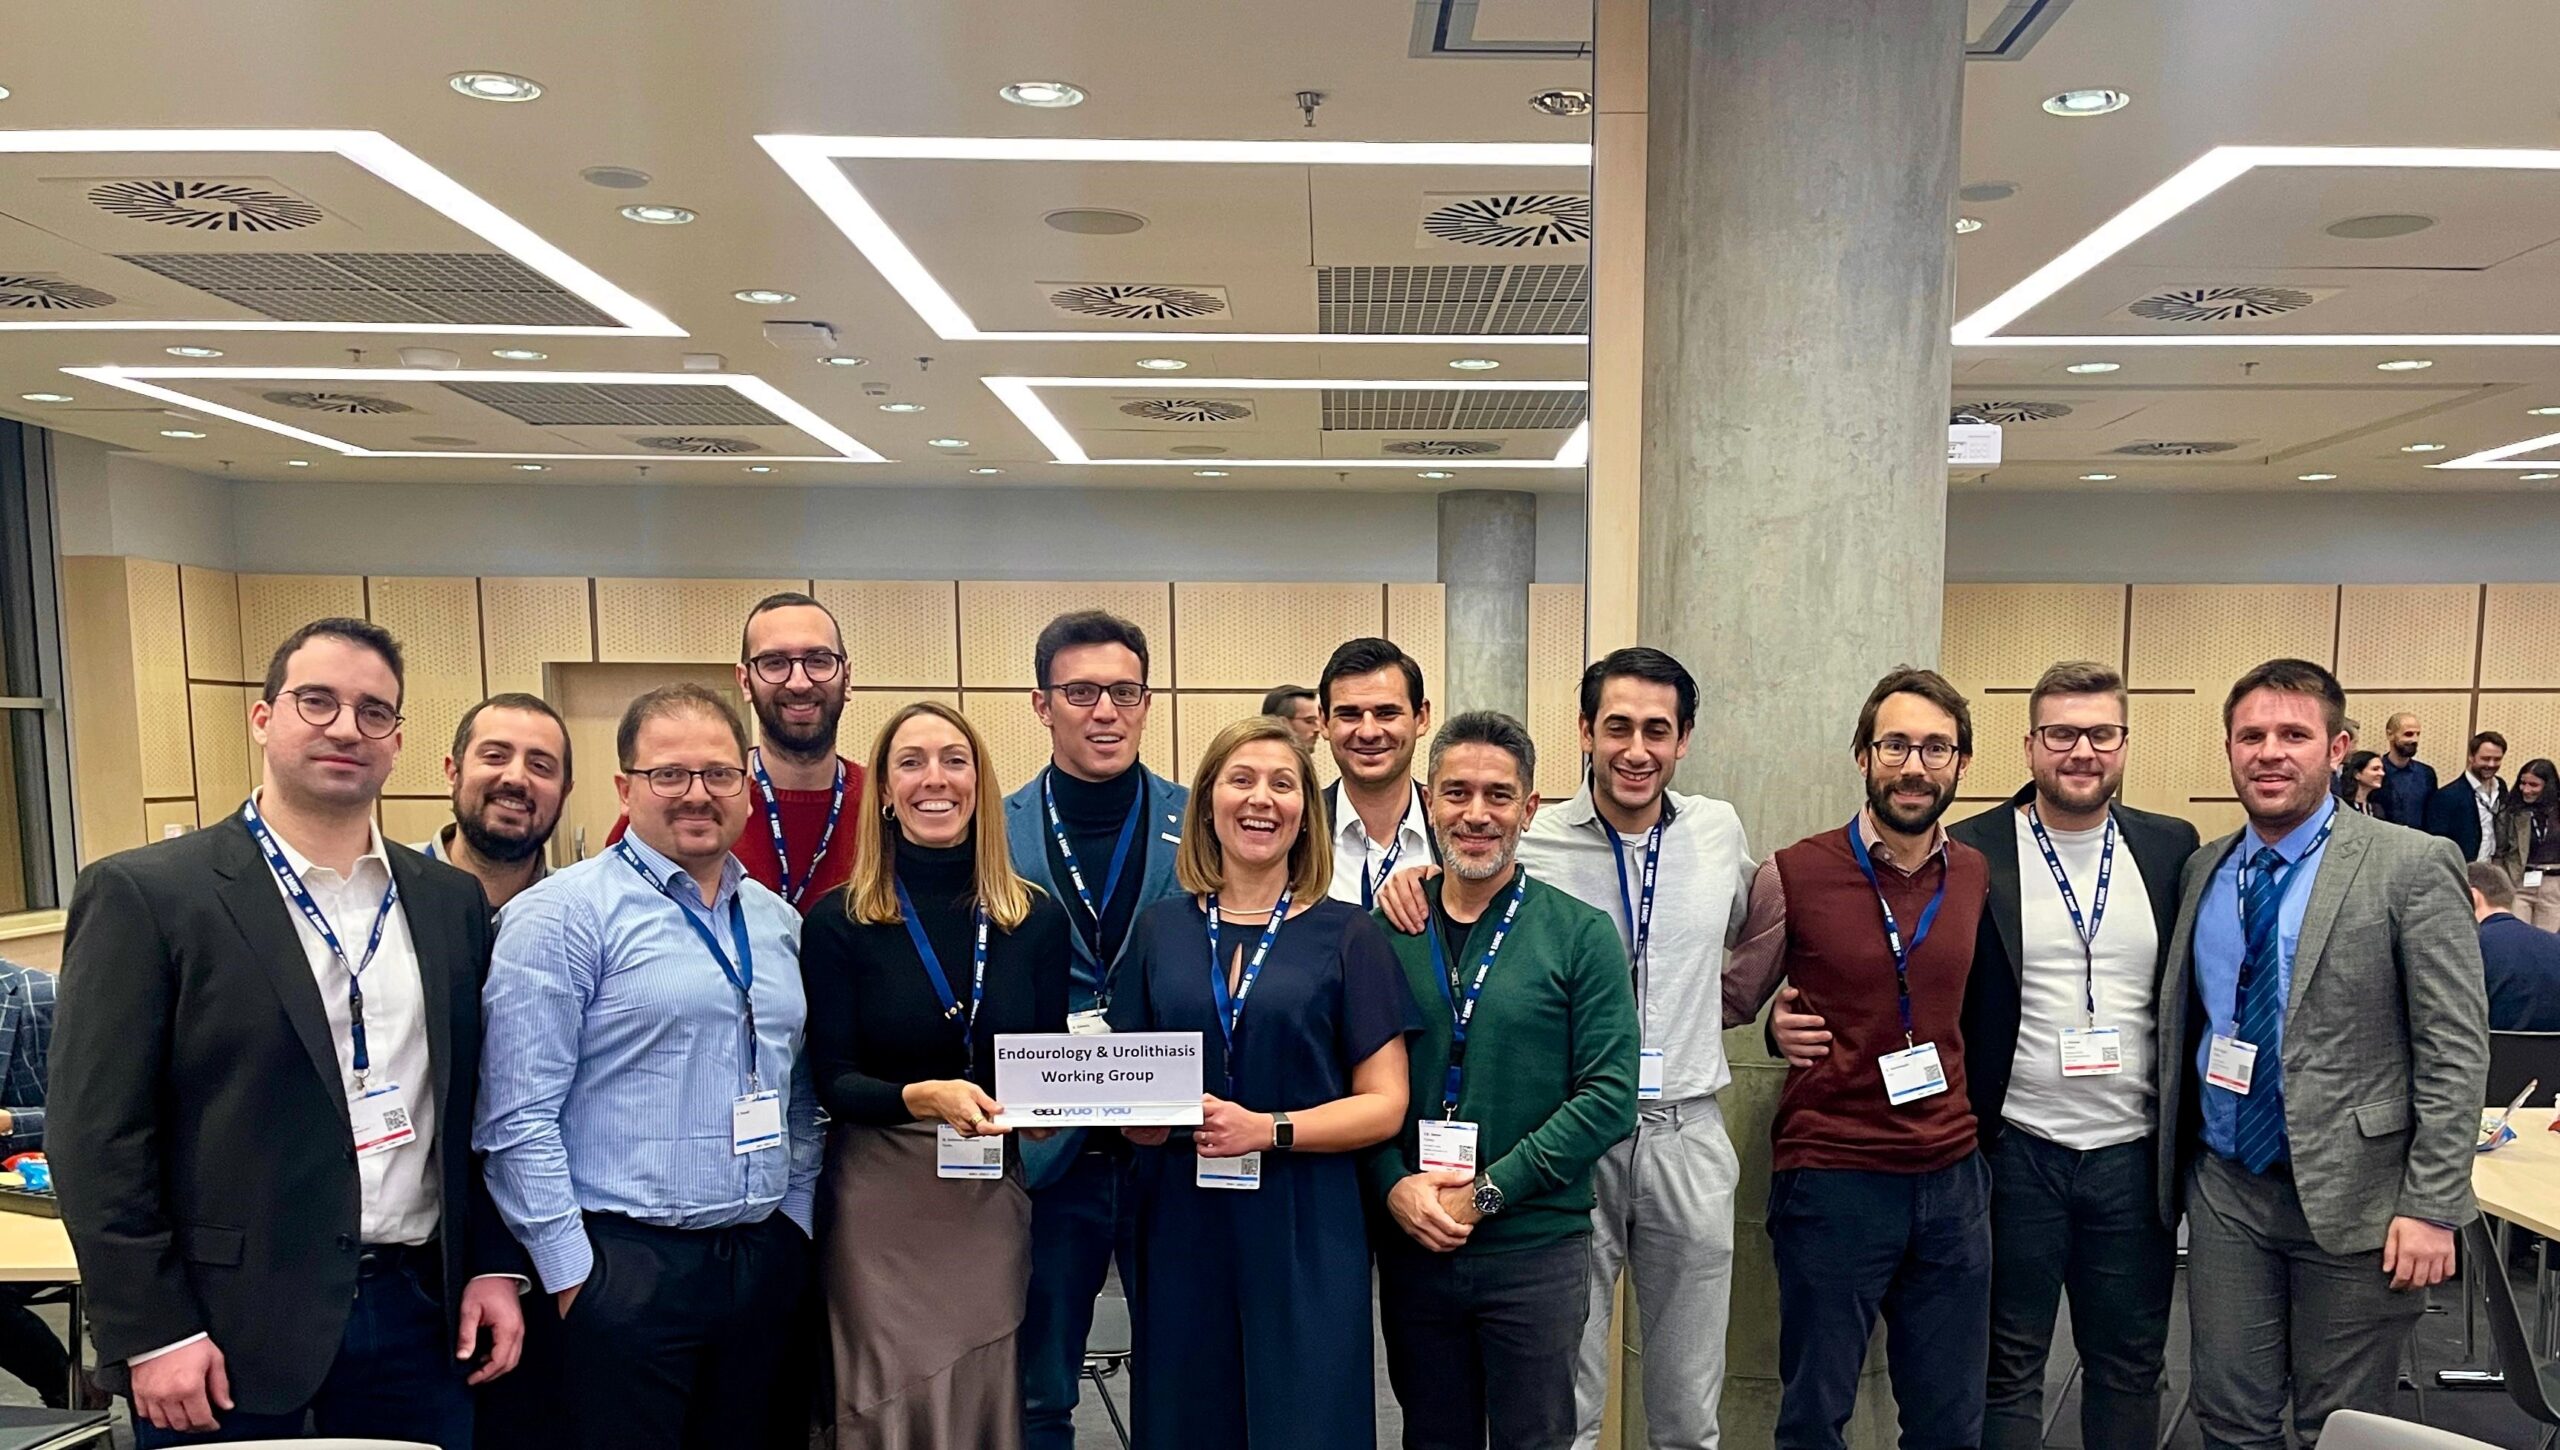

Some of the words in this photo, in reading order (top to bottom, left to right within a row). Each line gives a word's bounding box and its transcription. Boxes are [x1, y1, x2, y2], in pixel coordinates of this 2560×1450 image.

[998, 1047, 1092, 1061] Endourology
[1096, 1046, 1108, 1058] &
[1113, 1045, 1195, 1058] Urolithiasis
[1041, 1070, 1104, 1084] Working
[1108, 1069, 1154, 1083] Group
